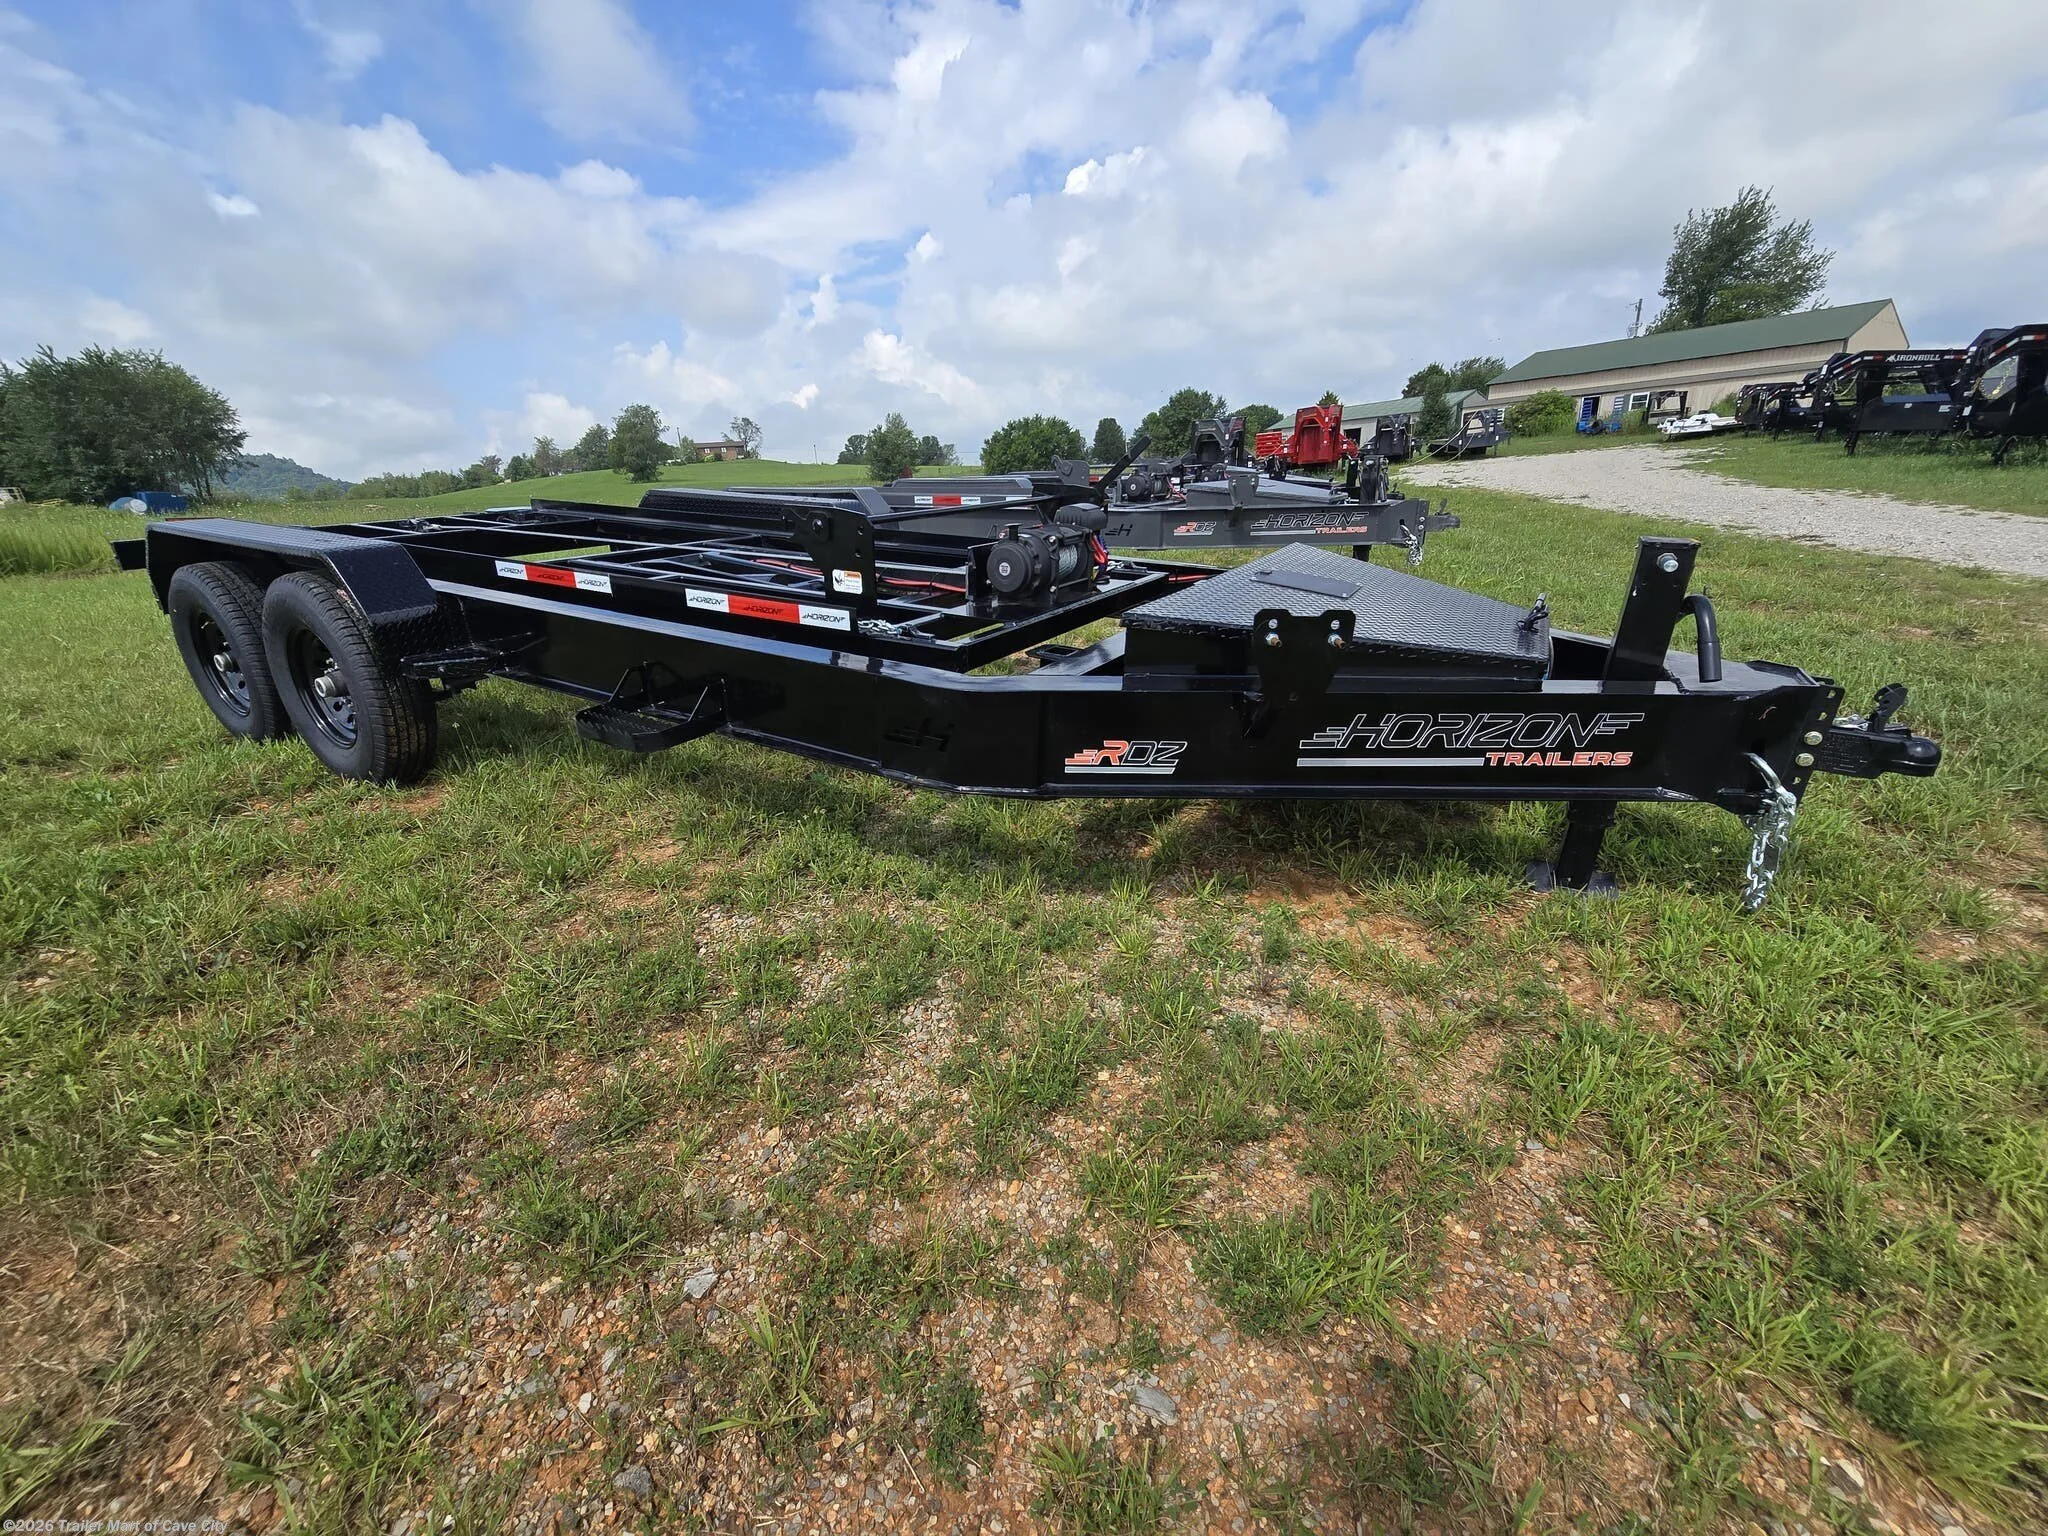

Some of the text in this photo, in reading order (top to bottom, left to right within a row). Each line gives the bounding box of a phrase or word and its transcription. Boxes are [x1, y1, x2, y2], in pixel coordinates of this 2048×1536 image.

[1264, 512, 1356, 528] HORIZON
[1315, 526, 1368, 534] TRAILERS
[694, 596, 721, 606] HORIZON
[748, 604, 780, 615] HORIZON
[805, 612, 842, 623] HORIZON
[1338, 713, 1615, 748] HORIZON
[1093, 740, 1188, 767] RDZ
[1485, 752, 1634, 767] TRAILERS
